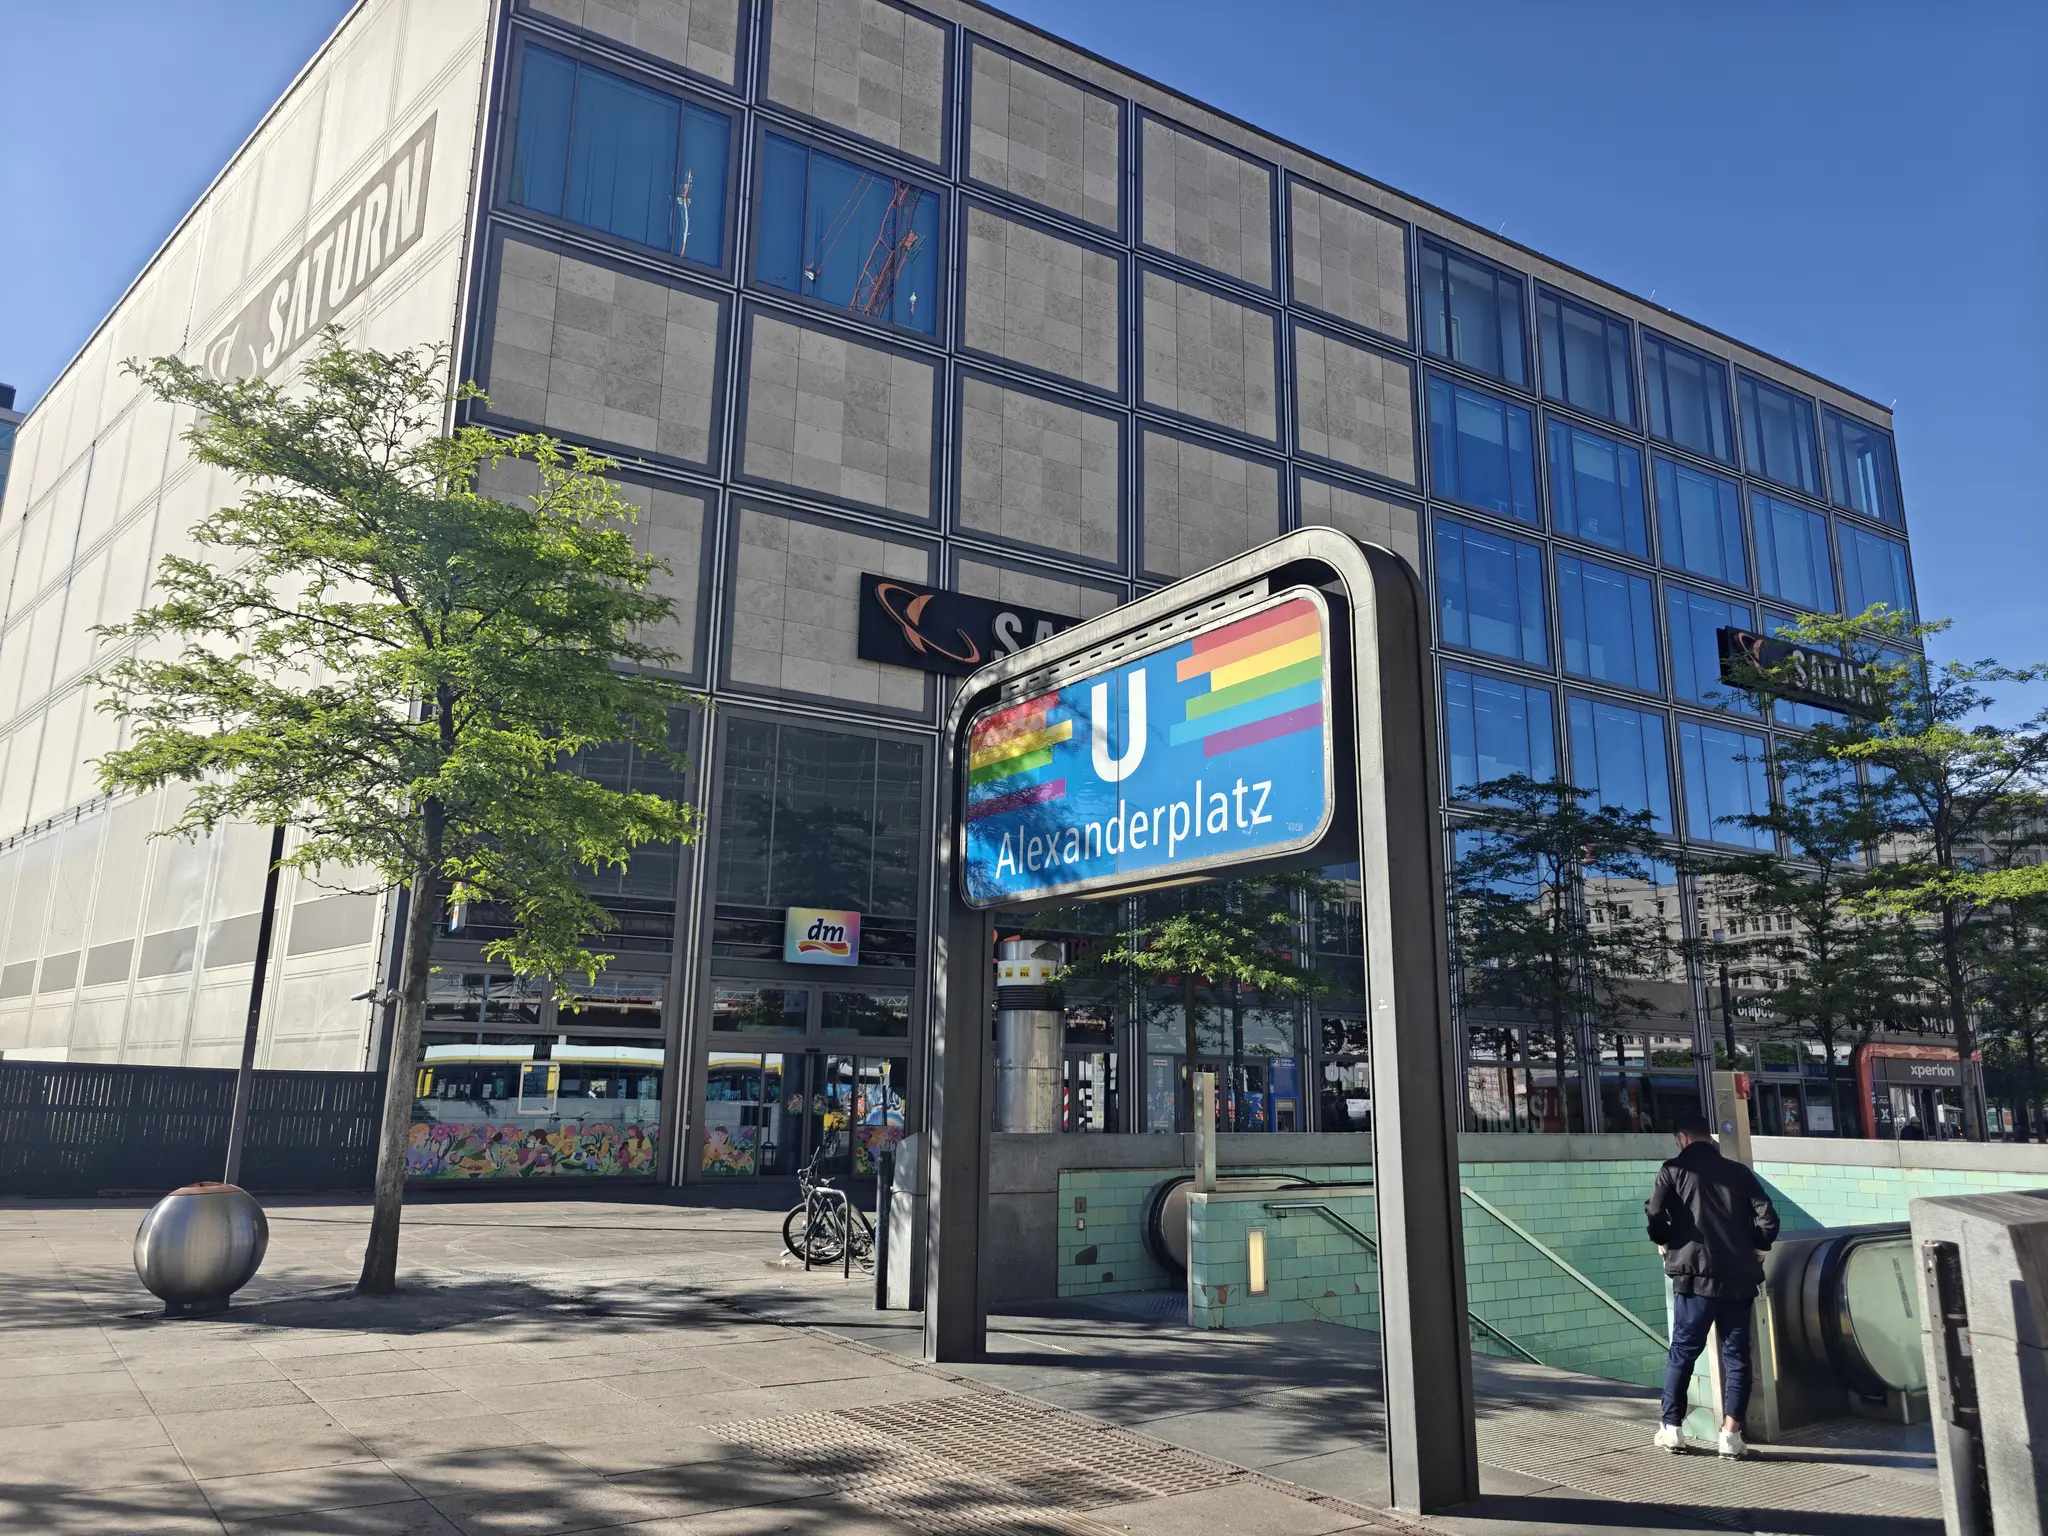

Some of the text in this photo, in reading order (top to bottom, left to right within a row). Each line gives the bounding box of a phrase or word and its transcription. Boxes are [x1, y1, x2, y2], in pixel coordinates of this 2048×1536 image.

[262, 138, 427, 370] SATURN
[1090, 667, 1147, 783] U
[995, 777, 1273, 879] Alexanderplatz
[807, 917, 844, 942] dm
[1910, 1063, 1955, 1079] xperion
